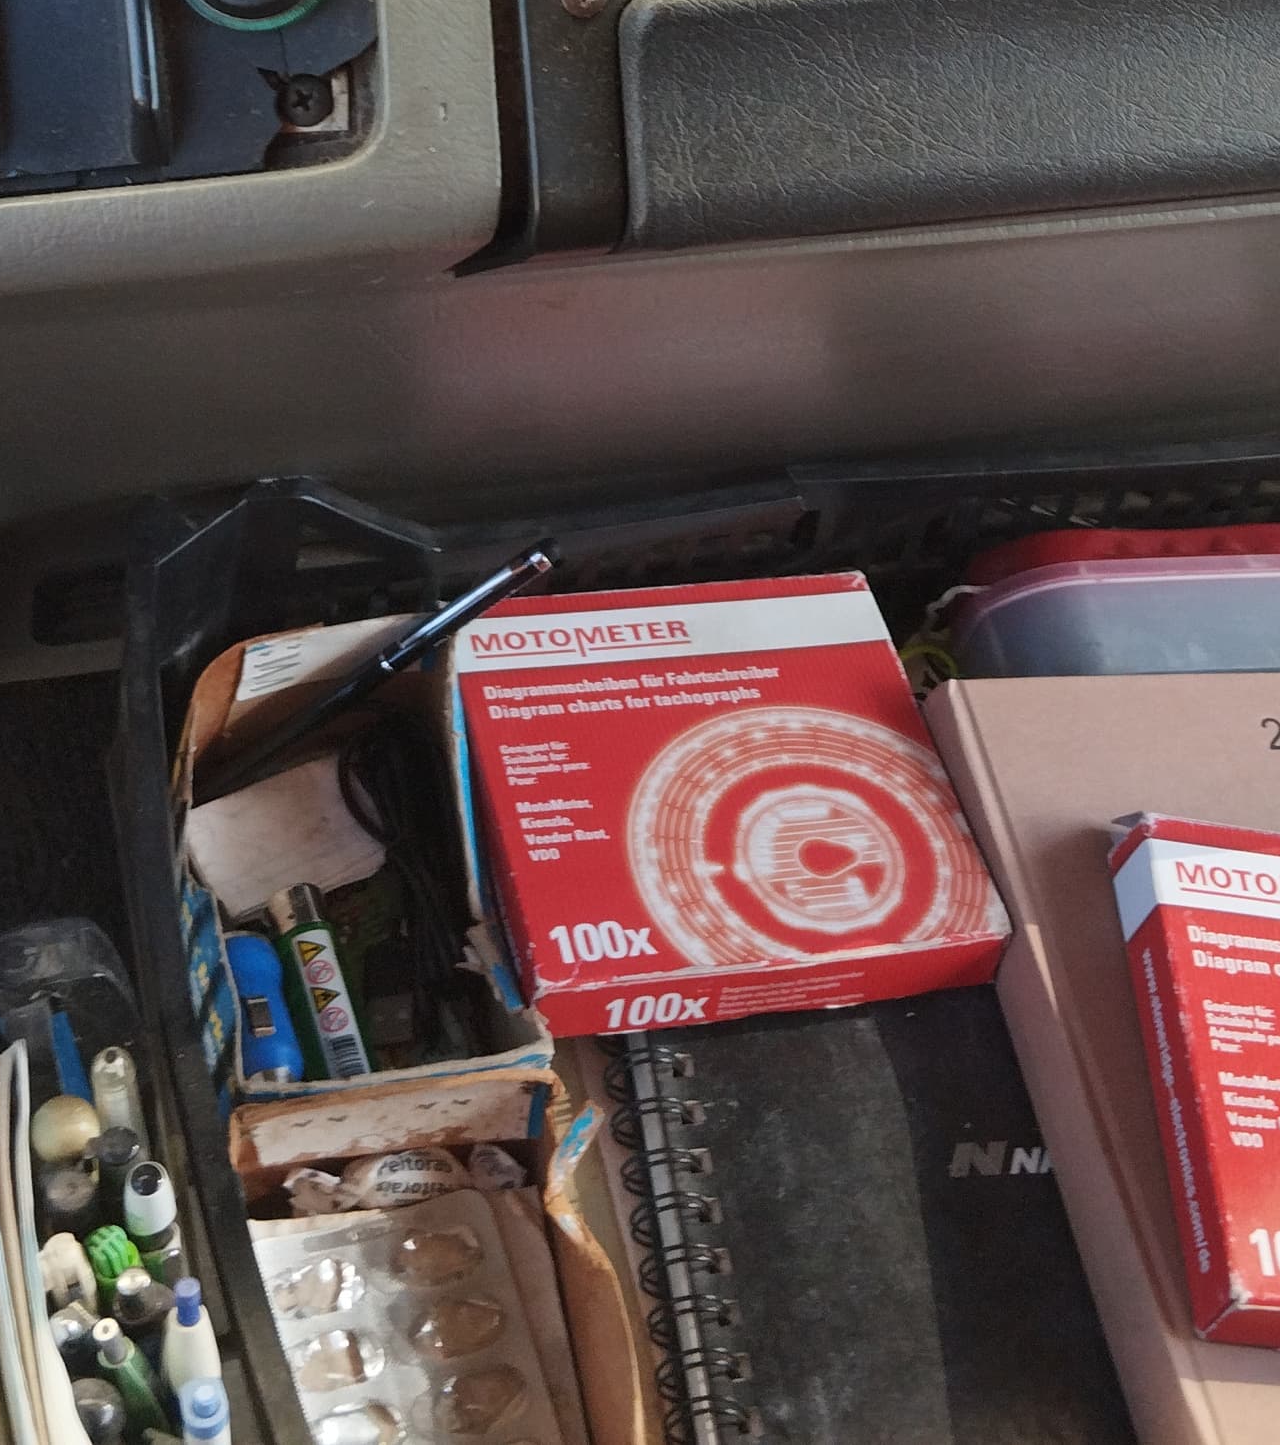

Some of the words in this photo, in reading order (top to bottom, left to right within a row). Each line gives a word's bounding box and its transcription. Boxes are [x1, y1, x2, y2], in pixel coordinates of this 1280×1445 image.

[470, 620, 689, 656] MOTOMETER
[482, 676, 639, 701] Diagrammscheiben
[641, 674, 664, 688] für
[666, 666, 779, 686] Fahrtschreiber
[488, 702, 564, 720] Diagram
[569, 697, 623, 714] charts
[625, 694, 651, 710] for
[653, 686, 760, 707] tachographs
[549, 921, 658, 964] 100x
[1192, 949, 1271, 975] Diagram
[605, 992, 710, 1028] 100x
